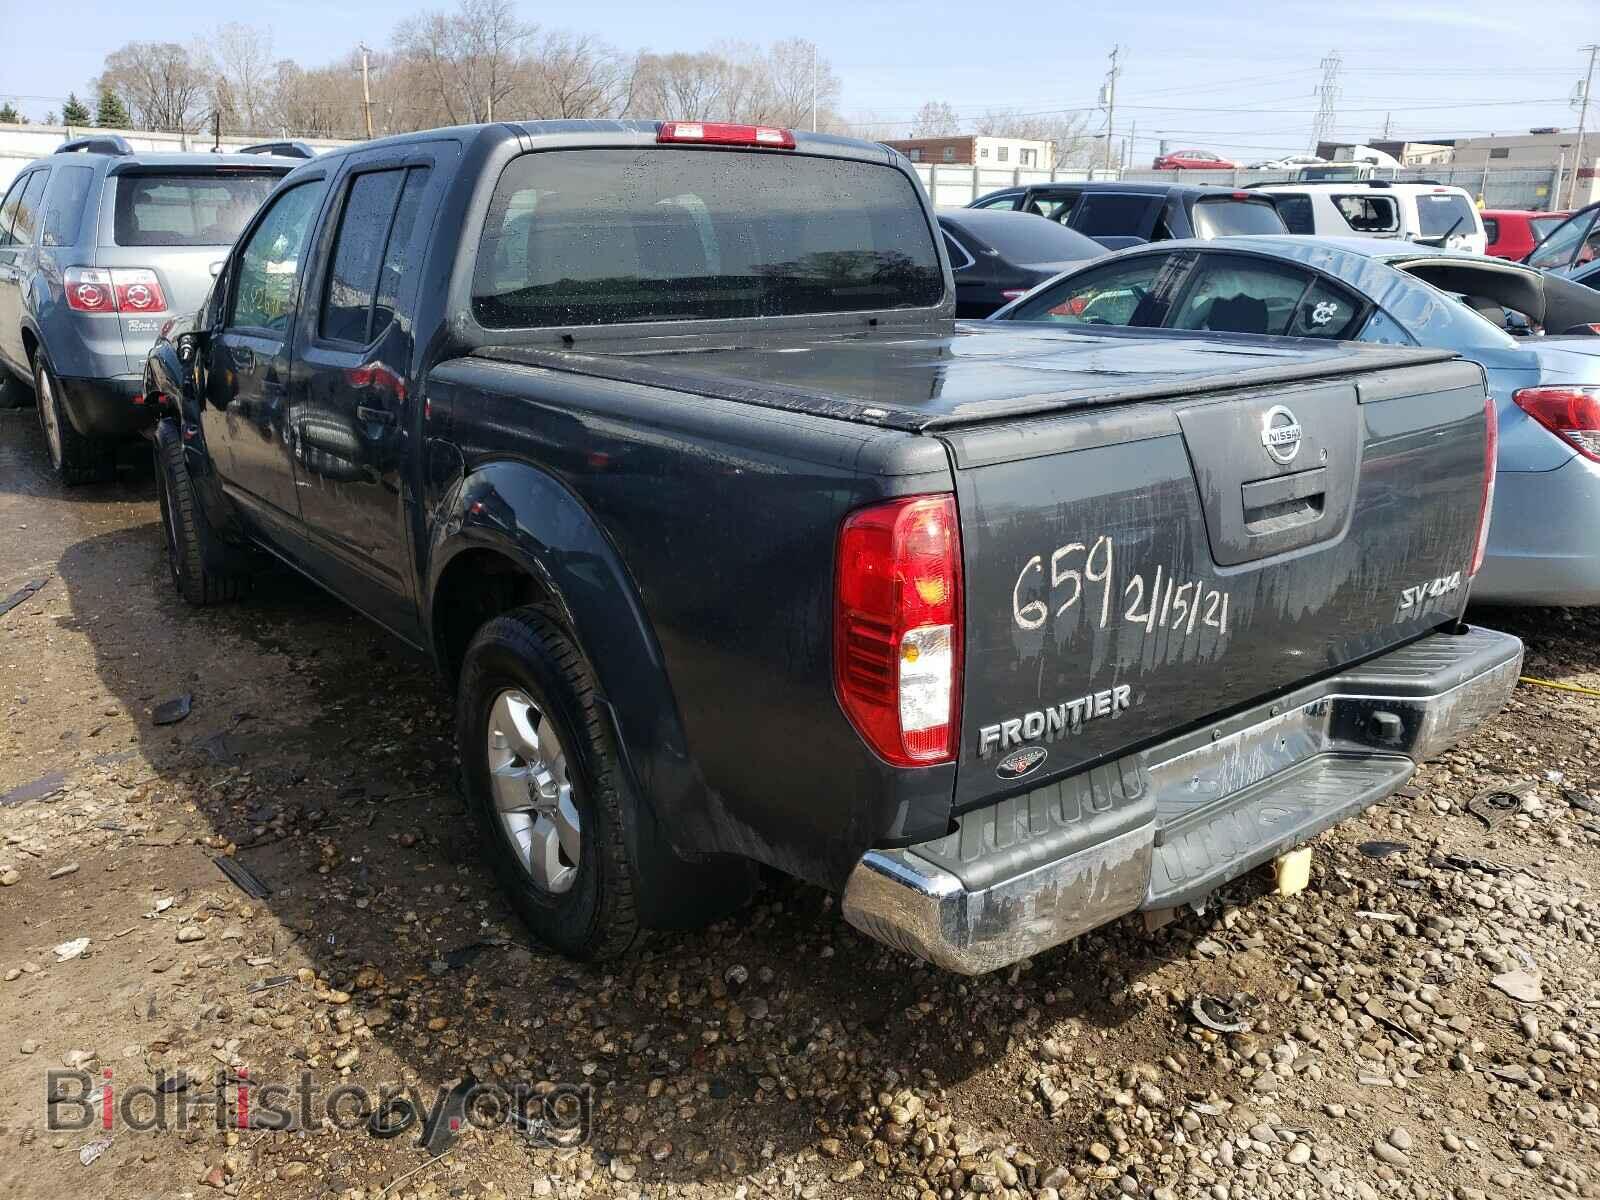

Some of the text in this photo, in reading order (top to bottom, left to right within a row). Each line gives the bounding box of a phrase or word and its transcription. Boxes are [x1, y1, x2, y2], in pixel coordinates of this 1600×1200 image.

[1013, 535, 1229, 635] 659 2/15/21
[1401, 582, 1429, 609] SV
[978, 684, 1131, 754] FRONTIER
